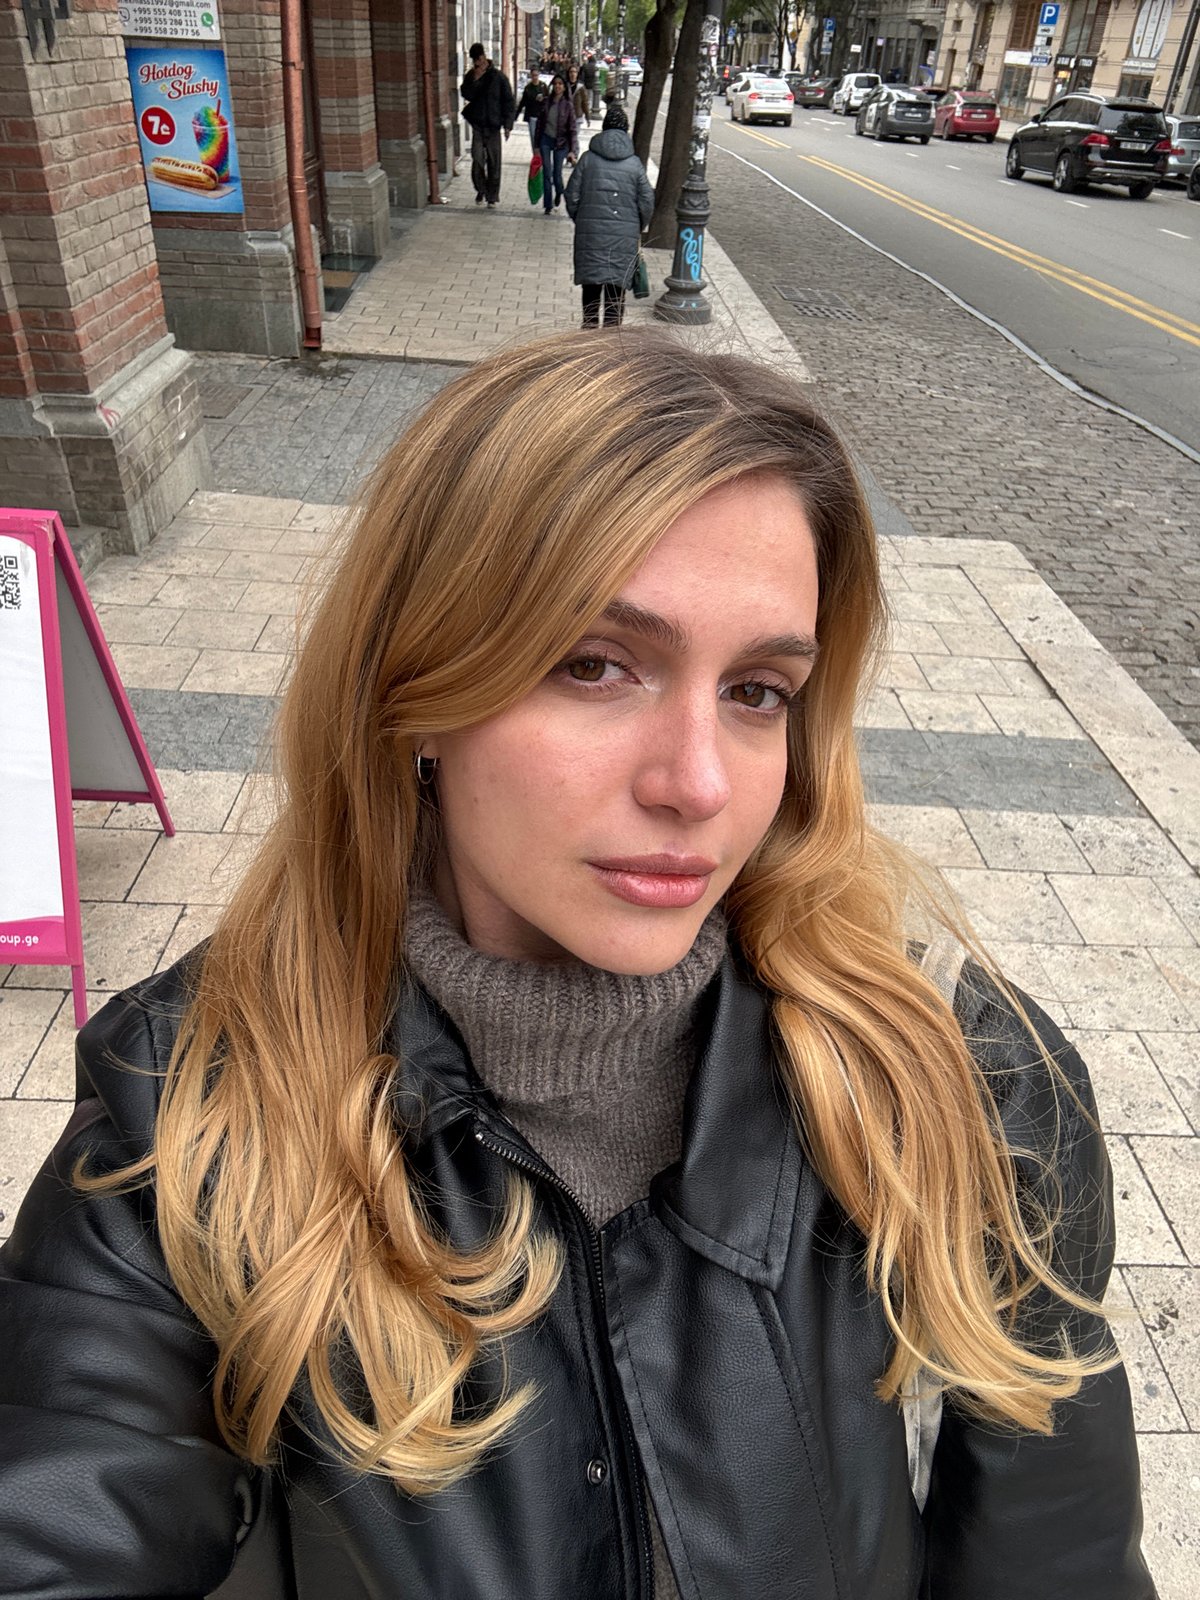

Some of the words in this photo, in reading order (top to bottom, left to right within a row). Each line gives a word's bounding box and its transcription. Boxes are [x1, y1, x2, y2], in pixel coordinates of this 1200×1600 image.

[133, 7, 151, 15] +995
[153, 8, 167, 16] 555
[184, 10, 198, 18] 111
[1043, 5, 1056, 23] P
[134, 17, 152, 25] +995
[185, 19, 198, 27] 111
[826, 19, 834, 30] P
[134, 26, 152, 34] +995
[180, 28, 189, 36] 77
[140, 62, 193, 83] Hotdog
[167, 78, 219, 99] Slushy
[0, 934, 39, 947] oup.ge
